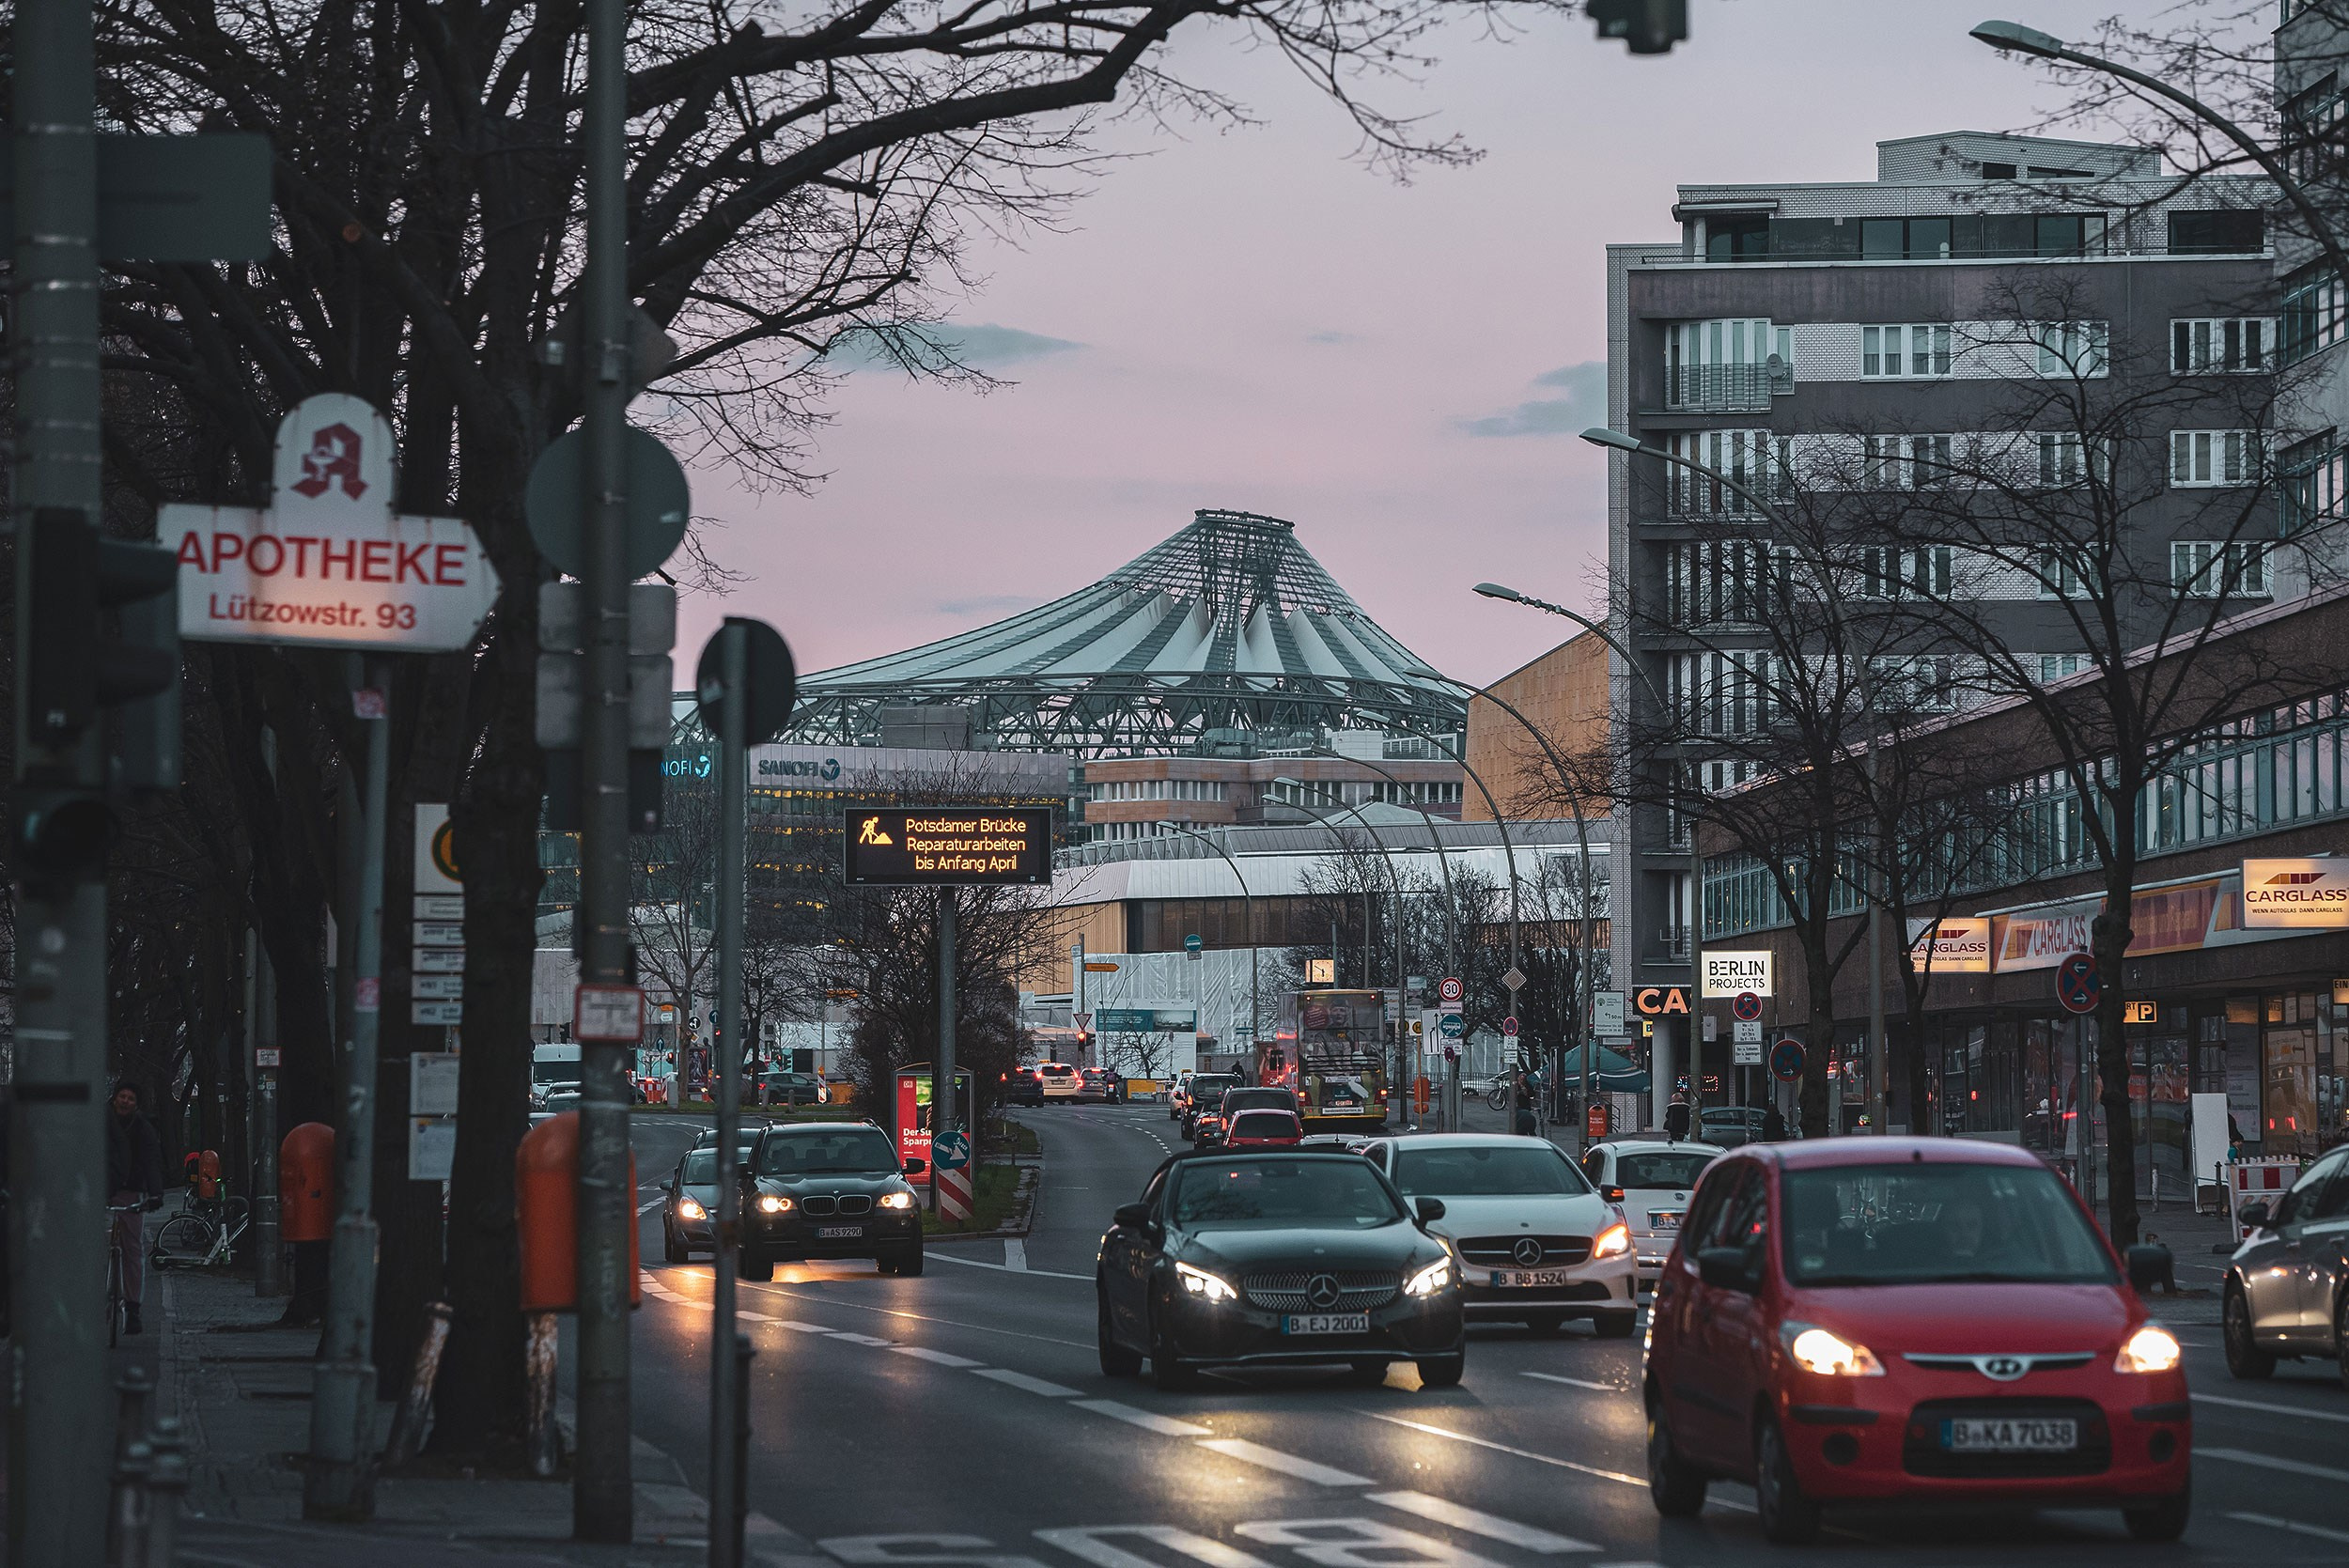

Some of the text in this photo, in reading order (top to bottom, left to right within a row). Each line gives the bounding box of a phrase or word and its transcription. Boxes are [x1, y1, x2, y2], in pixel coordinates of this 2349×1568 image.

[177, 531, 467, 586] APOTHEKE
[209, 593, 416, 629] Lützowstr. 93
[759, 759, 819, 776] SANOFI
[906, 817, 1026, 833] Potsdamer Brücke
[907, 837, 1026, 854] Reparaturarbeiten
[915, 855, 1017, 873] bis Anfang April
[2246, 889, 2347, 903] CARGLASS
[2033, 915, 2086, 956] CARGLASS
[1709, 960, 1766, 976] BERLIN
[1444, 984, 1458, 995] 30
[1709, 978, 1766, 989] PROJECTS
[1637, 988, 1691, 1015] CA
[2140, 1004, 2153, 1019] P
[1657, 1217, 1665, 1225] B
[831, 1228, 841, 1236] AS
[842, 1227, 862, 1236] 9290
[1499, 1271, 1563, 1285] B BB 1524
[1290, 1316, 1368, 1332] B EJ 2001
[1954, 1421, 1968, 1443] B
[1983, 1422, 2014, 1443] KA
